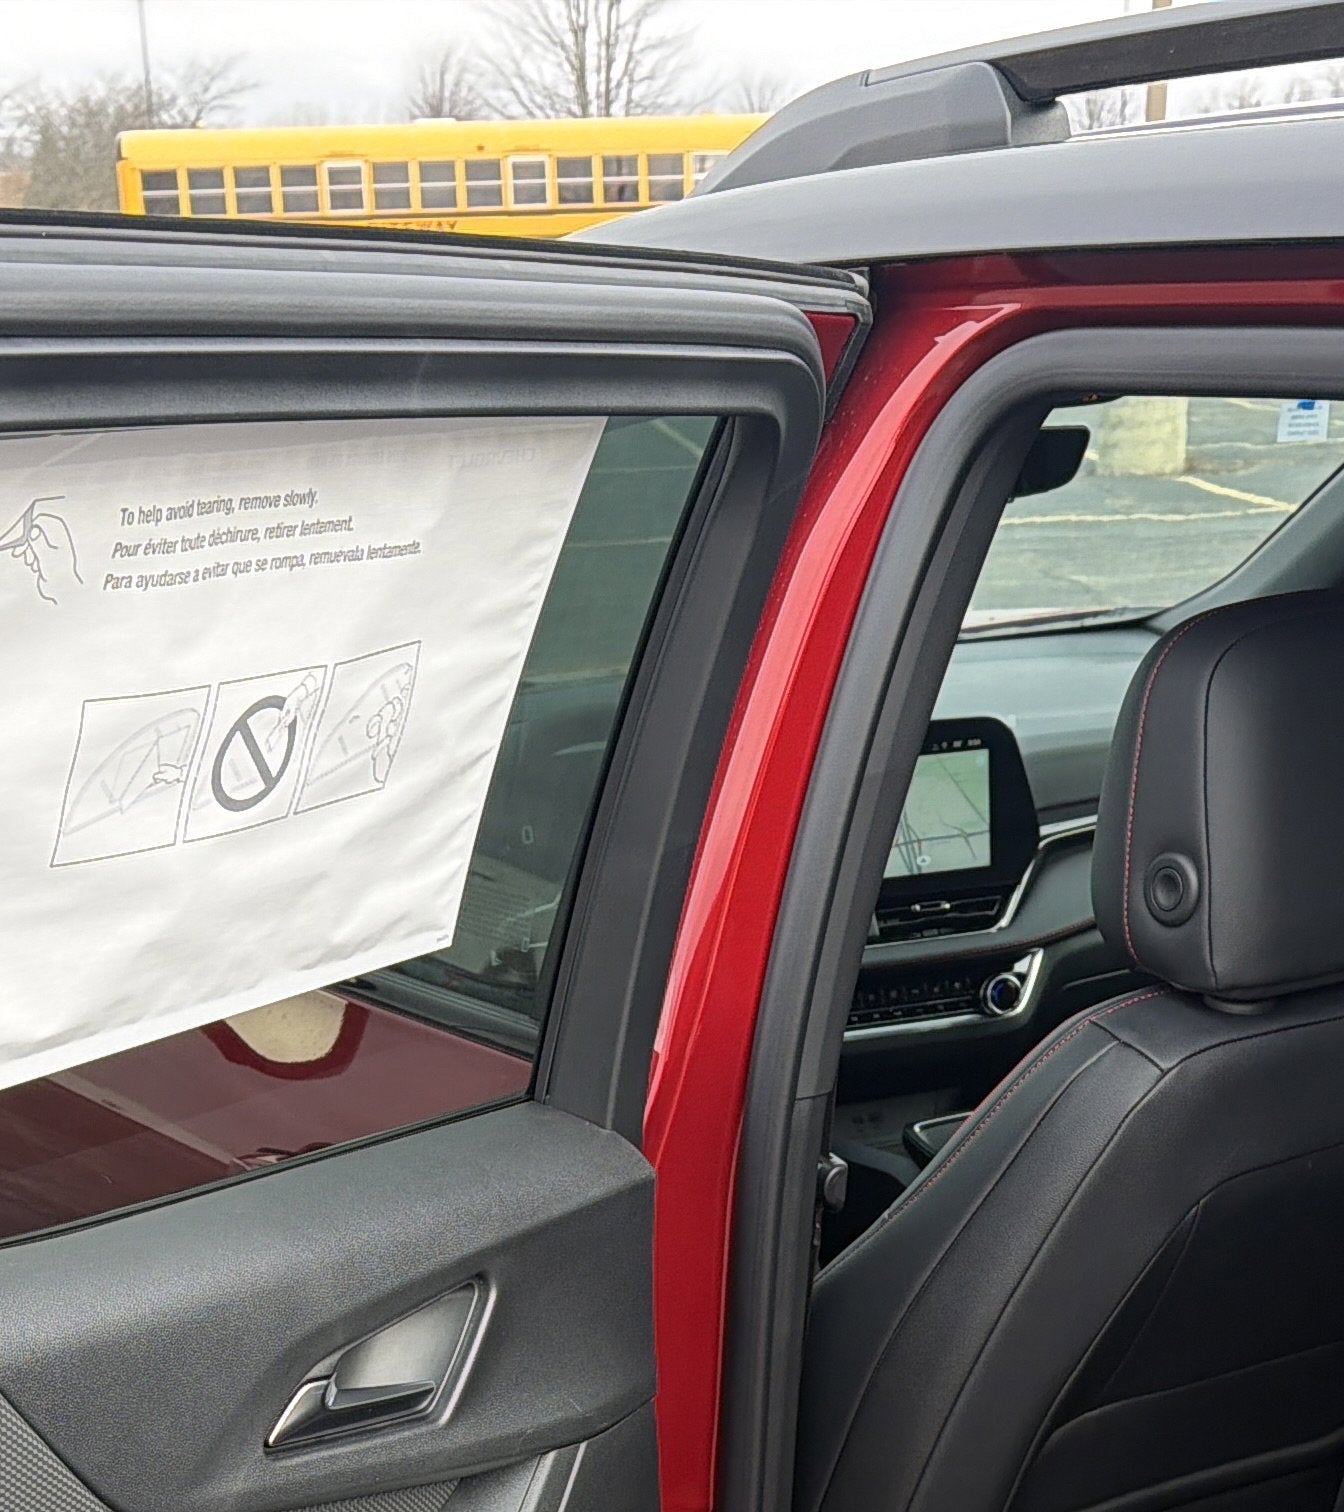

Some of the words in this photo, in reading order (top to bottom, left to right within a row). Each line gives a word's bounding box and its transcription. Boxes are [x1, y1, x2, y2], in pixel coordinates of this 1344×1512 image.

[120, 507, 135, 526] To
[137, 504, 163, 526] help
[165, 499, 195, 522] avoid
[196, 495, 236, 516] tearing,
[238, 494, 281, 511] remove
[283, 487, 318, 508] slowly.
[111, 541, 143, 559] Pour
[143, 537, 179, 556] éviter
[181, 533, 207, 552] toute
[264, 521, 299, 540] retirer
[299, 515, 354, 537] lentement.
[103, 573, 133, 590] Para
[135, 570, 191, 591] ayudarse
[192, 568, 200, 583] a
[201, 561, 230, 581] evitar
[231, 558, 253, 578] que
[254, 557, 269, 573] se
[270, 552, 307, 572] rompa,
